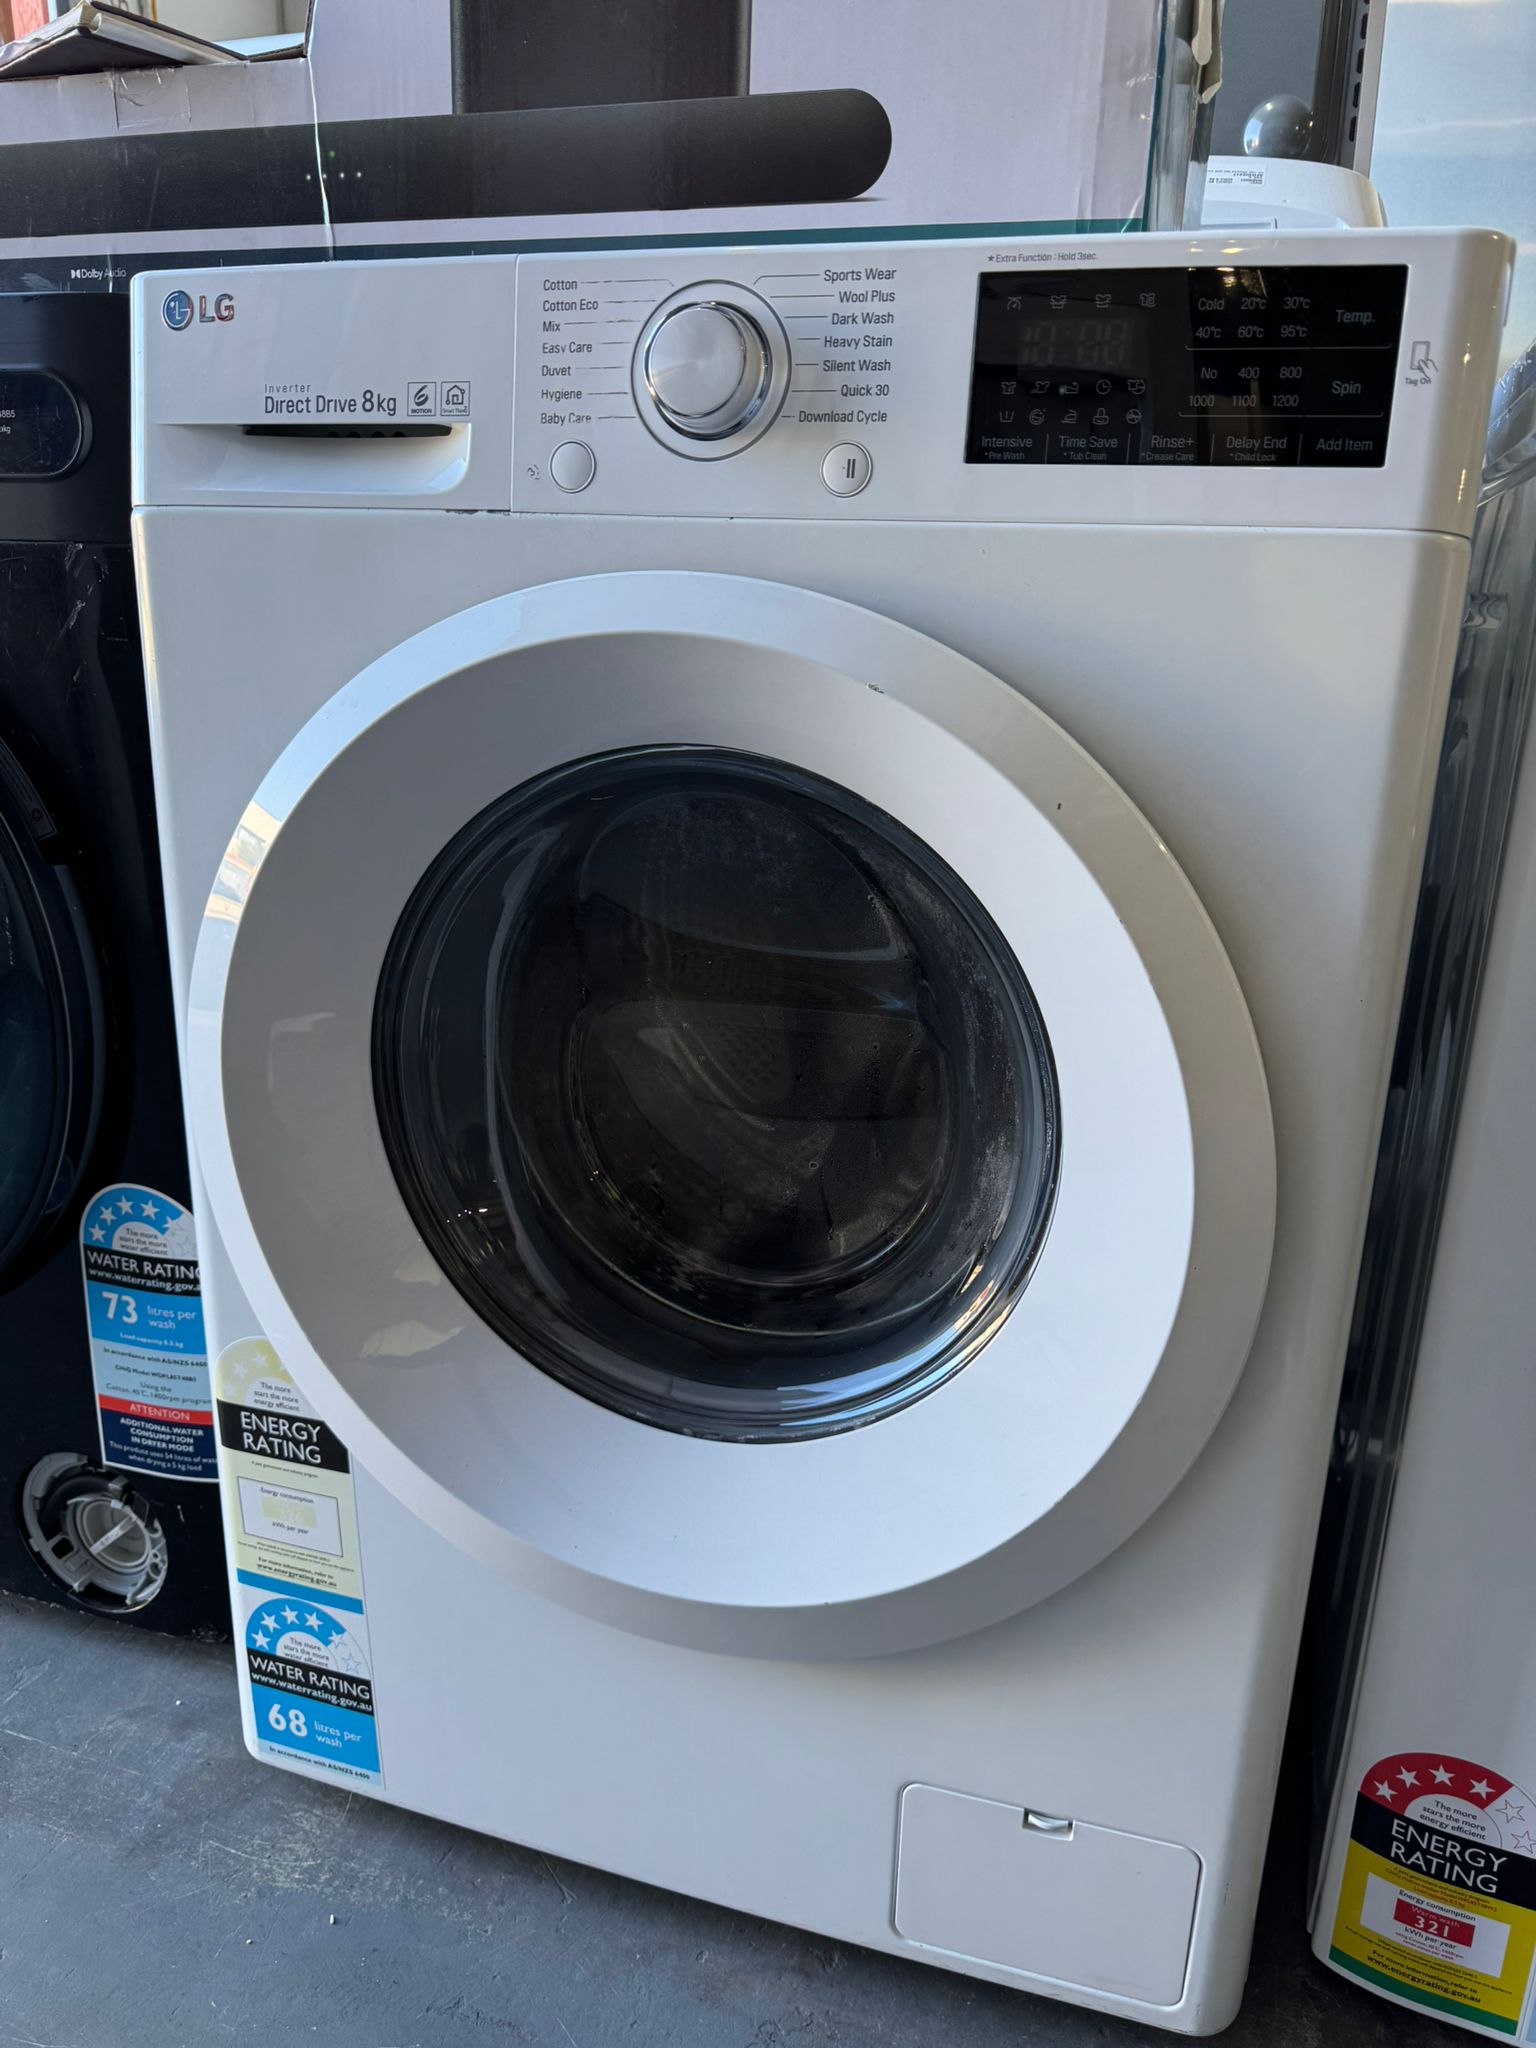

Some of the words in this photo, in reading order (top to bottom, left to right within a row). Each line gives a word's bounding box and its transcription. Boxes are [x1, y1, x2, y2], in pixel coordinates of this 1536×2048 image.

[995, 254, 1016, 263] Extra
[1018, 253, 1052, 262] Function
[1058, 253, 1076, 261] Hold
[82, 269, 103, 280] Dolby
[104, 268, 126, 279] Audio
[824, 269, 862, 284] Sports
[864, 268, 897, 281] Wear
[543, 279, 578, 291] Cotton
[839, 291, 868, 303] Wool
[871, 290, 896, 302] Plus
[199, 293, 235, 323] LG
[543, 300, 577, 312] Cotton
[580, 298, 598, 311] Eco
[1198, 298, 1225, 310] Cold
[832, 313, 858, 325] Dark
[861, 312, 894, 324] Wash
[1336, 310, 1375, 325] Temp.
[543, 321, 561, 332] Mix
[542, 342, 567, 355] Easy
[569, 341, 592, 353] Care
[824, 335, 860, 350] Heavy
[863, 334, 893, 347] Stain
[542, 365, 571, 376] Duvet
[823, 359, 855, 372] Silent
[858, 359, 891, 371] Wash
[1200, 368, 1217, 379] No
[1238, 367, 1259, 379] 400
[1280, 367, 1302, 379] 800
[264, 384, 311, 393] Inverter
[1332, 381, 1361, 396] Spin
[1405, 378, 1418, 386] Tag
[1420, 377, 1432, 385] On
[541, 388, 582, 402] Hygiene
[841, 384, 873, 397] Quick
[875, 384, 889, 396] 30
[264, 395, 311, 414] Direct
[316, 394, 357, 413] Drive
[1189, 395, 1215, 407] 1000
[1232, 395, 1257, 407] 1100
[1272, 395, 1299, 406] 1200
[541, 413, 568, 426] Baby
[569, 412, 592, 424] Care
[799, 410, 854, 423] Download
[856, 410, 887, 424] Cycle
[981, 436, 1033, 448] Intensive
[1059, 435, 1086, 448] Time
[1089, 436, 1118, 448] Save
[1151, 435, 1195, 448] Rinse+
[1226, 436, 1260, 451] Delay
[1263, 436, 1287, 449] End
[1316, 438, 1342, 451] Add
[1345, 438, 1373, 451] Item
[1003, 452, 1025, 460] Wash
[1085, 452, 1107, 460] Clean
[1174, 452, 1194, 461] Care
[1257, 452, 1276, 462] Lock
[126, 1228, 138, 1236] The
[140, 1231, 158, 1239] more
[141, 1246, 168, 1255] efficient
[148, 1240, 167, 1248] more
[87, 1250, 139, 1273] WATER
[102, 1291, 138, 1324] 73
[147, 1305, 174, 1318] litres
[178, 1310, 197, 1321] per
[148, 1318, 176, 1330] wash
[140, 1382, 159, 1391] Using
[160, 1385, 172, 1393] the
[261, 1382, 272, 1390] The
[274, 1386, 291, 1394] more
[254, 1390, 269, 1398] stars
[270, 1392, 280, 1400] the
[282, 1396, 299, 1404] more
[254, 1398, 274, 1408] energy
[276, 1401, 300, 1411] efficient
[129, 1403, 191, 1421] ATTENTION
[120, 1417, 172, 1434] ADDITIONAL
[172, 1426, 204, 1437] WATER
[240, 1411, 321, 1443] ENERGY
[130, 1427, 194, 1444] CONSUMPTION
[109, 1440, 122, 1449] This
[193, 1454, 201, 1462] of
[142, 1437, 168, 1449] DRYER
[168, 1442, 195, 1453] MODE
[243, 1432, 321, 1464] RATING
[128, 1454, 145, 1462] when
[146, 1456, 166, 1468] drying
[177, 1461, 186, 1470] kg
[187, 1463, 202, 1471] load
[261, 1487, 279, 1497] Energy
[280, 1491, 314, 1504] consumption
[290, 1637, 302, 1646] The
[304, 1642, 321, 1651] more
[283, 1644, 300, 1653] stars
[301, 1647, 311, 1656] the
[312, 1652, 330, 1661] more
[284, 1652, 302, 1661] water
[304, 1655, 328, 1668] efficient
[250, 1655, 305, 1682] WATER
[309, 1672, 370, 1699] RATING
[251, 1672, 373, 1712] www.waterrating.gov.au
[268, 1704, 308, 1738] 68
[314, 1720, 340, 1737] litres
[344, 1731, 362, 1743] per
[315, 1734, 342, 1748] wash
[277, 1749, 312, 1763] accordance
[313, 1758, 327, 1767] with
[1434, 1800, 1451, 1812] The
[1453, 1808, 1477, 1820] more
[1422, 1806, 1443, 1818] stars
[1446, 1812, 1460, 1823] the
[1462, 1818, 1486, 1832] more
[1420, 1814, 1449, 1829] energy
[1451, 1823, 1486, 1841] efficient
[1391, 1818, 1508, 1873] ENERGY
[1390, 1841, 1498, 1894] RATING
[1399, 1890, 1425, 1905] Energy
[1426, 1900, 1476, 1921] consumption
[1411, 1905, 1437, 1920] Warm
[1439, 1915, 1460, 1928] wash
[1404, 1926, 1424, 1939] kWh
[1425, 1933, 1438, 1944] per
[1440, 1939, 1457, 1950] year
[1372, 1949, 1384, 1958] For
[1386, 1956, 1405, 1968] more
[1406, 1964, 1450, 1985] information,
[1451, 1981, 1468, 1991] refer
[1366, 1954, 1481, 2003] www.energyrating.gov.au
